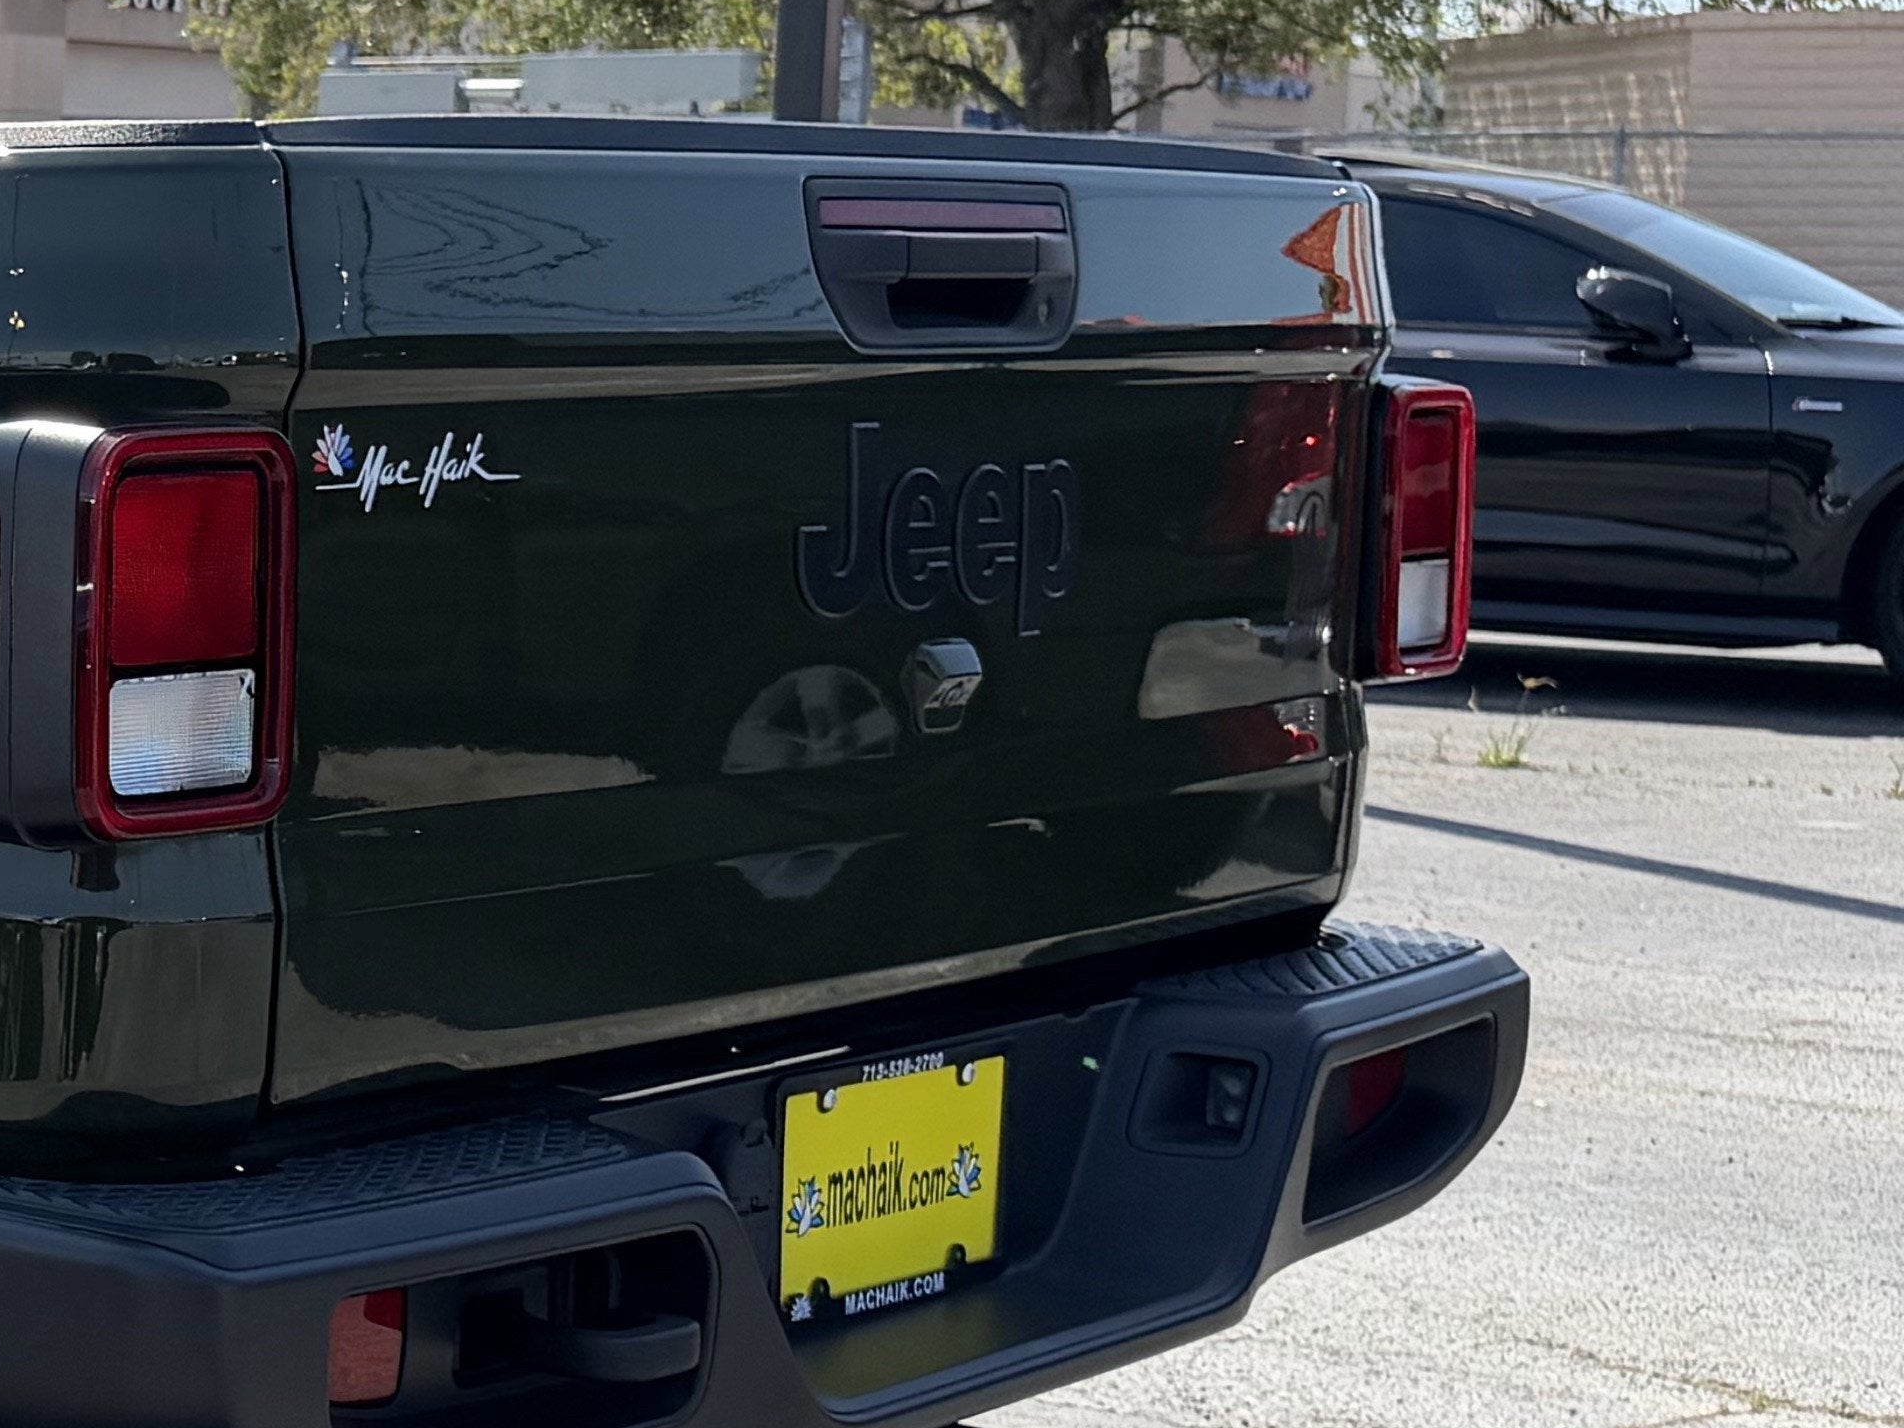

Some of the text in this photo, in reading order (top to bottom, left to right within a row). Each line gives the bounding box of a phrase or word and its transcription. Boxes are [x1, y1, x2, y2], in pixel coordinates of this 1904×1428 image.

[315, 432, 522, 513] Mac Haik
[797, 422, 1080, 637] Jeep
[825, 1140, 946, 1228] machaik.com
[844, 1272, 945, 1316] MACHAIK.COM
